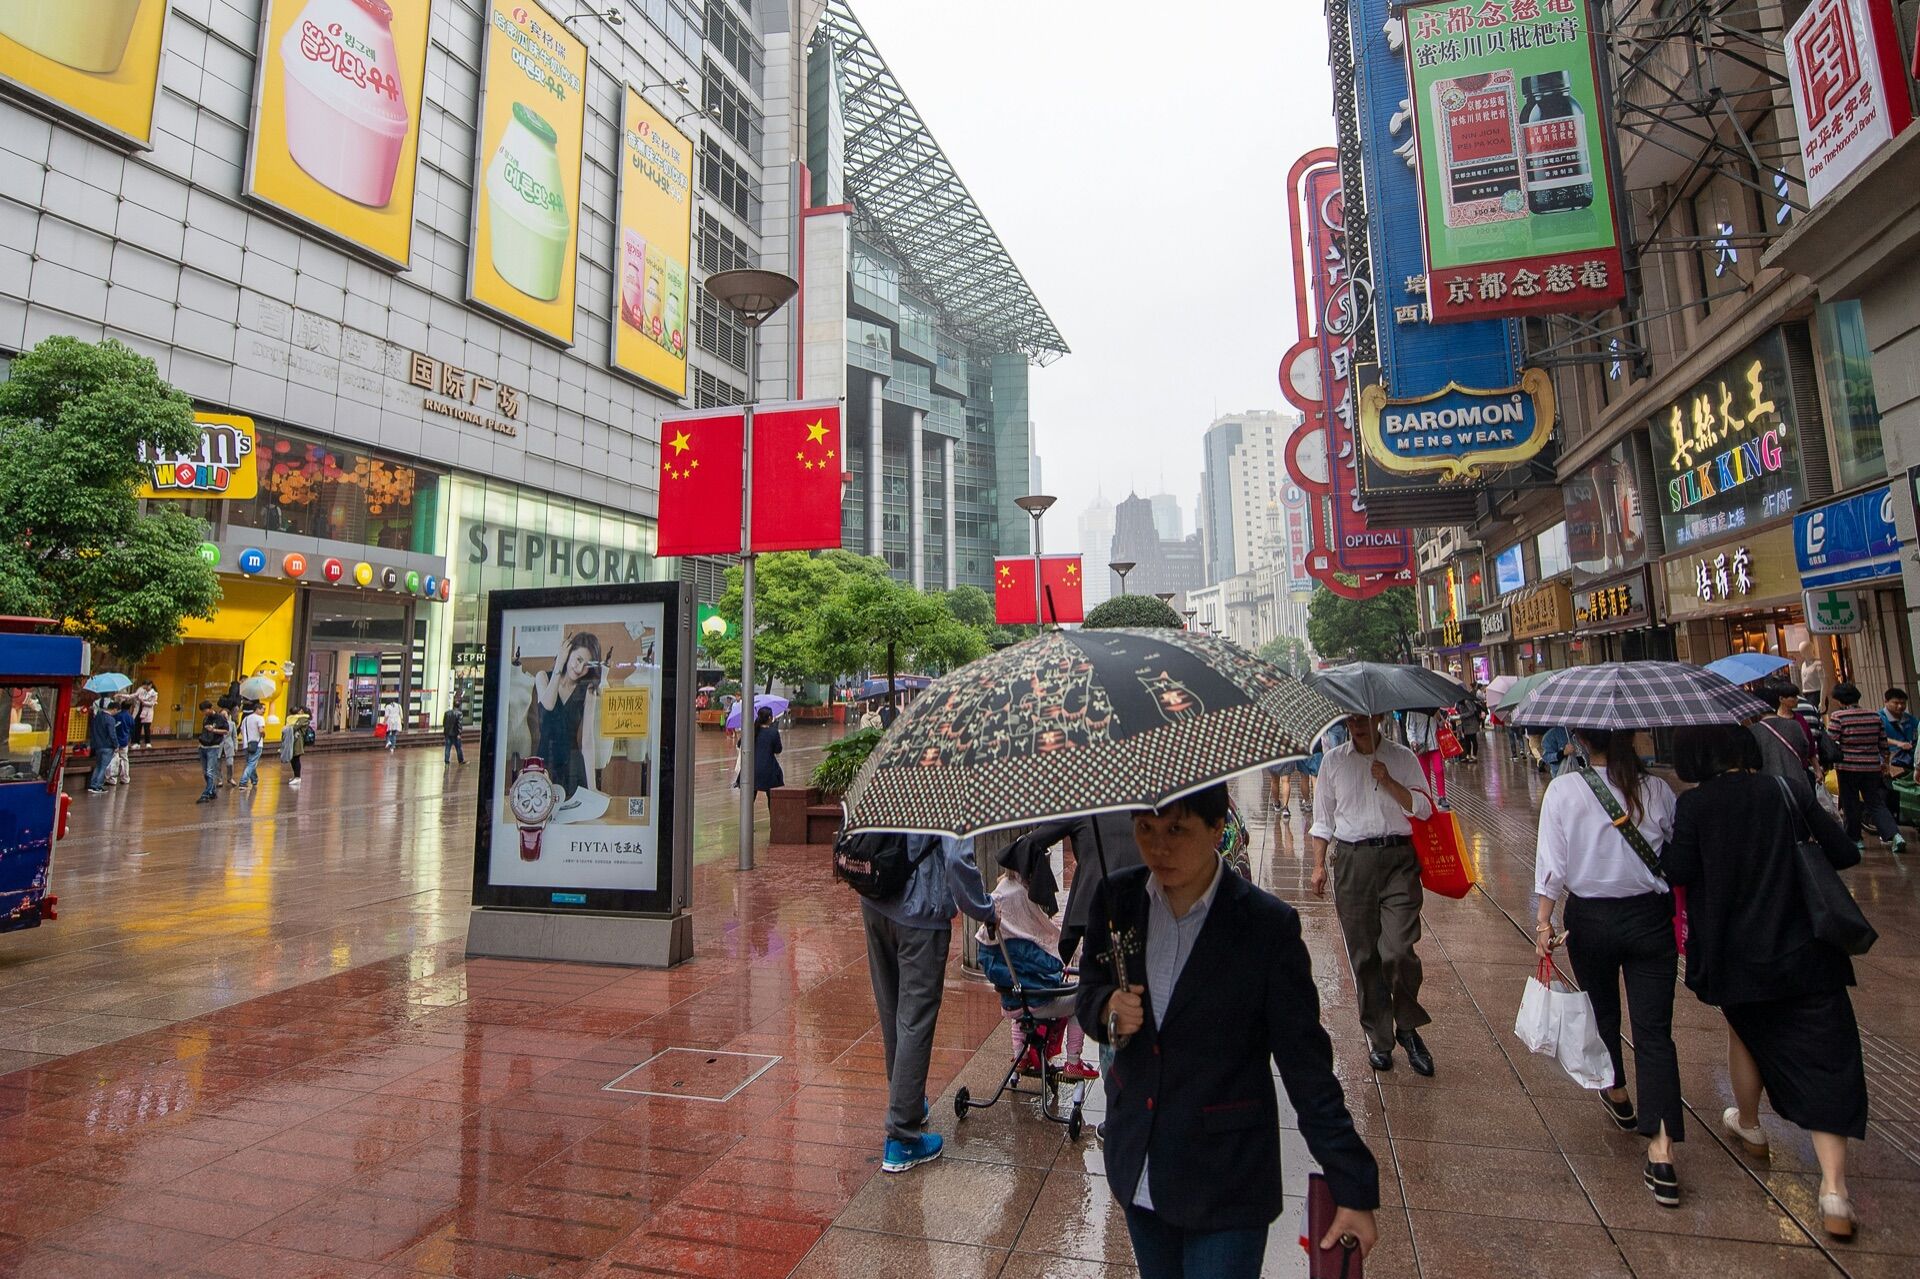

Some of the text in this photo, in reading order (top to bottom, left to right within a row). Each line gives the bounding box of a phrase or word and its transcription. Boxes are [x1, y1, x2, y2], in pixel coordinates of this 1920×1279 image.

[344, 31, 376, 62] 빙그레
[1416, 17, 1579, 68] 蜜炼川贝枇杷膏
[1479, 128, 1501, 137] JIOM
[1805, 81, 1873, 160] 中华老字号
[1457, 138, 1507, 151] PEI PA KOA
[1808, 106, 1877, 178] China Time-honored Brand
[409, 351, 520, 420] 国际广场
[424, 398, 518, 437] RNATIONAL PLAZA
[1386, 402, 1524, 434] BAROMON
[1397, 428, 1515, 450] MENS WEAR
[1669, 461, 1716, 512] SILK
[1716, 431, 1782, 492] KING
[1762, 487, 1793, 518] 2F/3F
[468, 524, 640, 584] SEPHORA
[1345, 532, 1400, 548] OPTICAL
[570, 841, 642, 854] FIYTA 飞亚达
